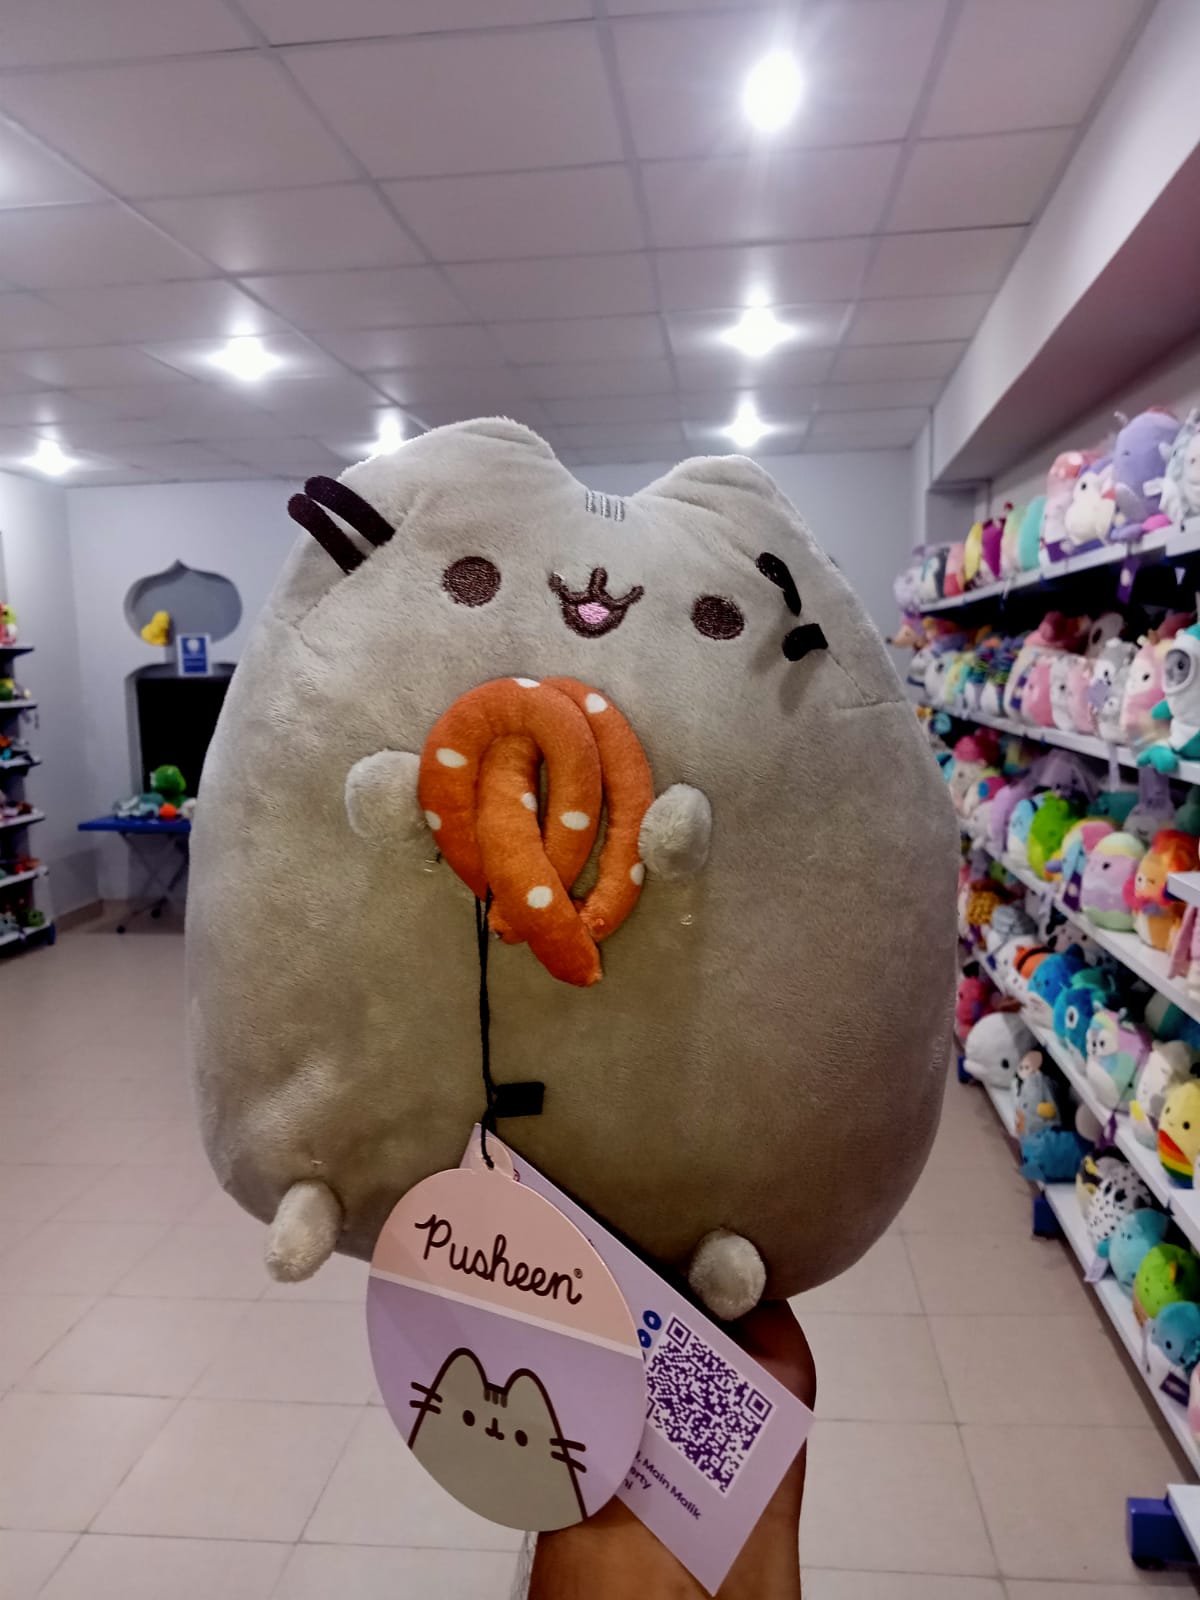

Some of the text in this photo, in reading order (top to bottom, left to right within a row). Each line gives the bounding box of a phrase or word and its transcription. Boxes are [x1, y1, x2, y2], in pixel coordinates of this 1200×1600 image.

[630, 1466, 652, 1490] erty
[642, 1458, 670, 1490] Main
[670, 1486, 701, 1520] Malik
